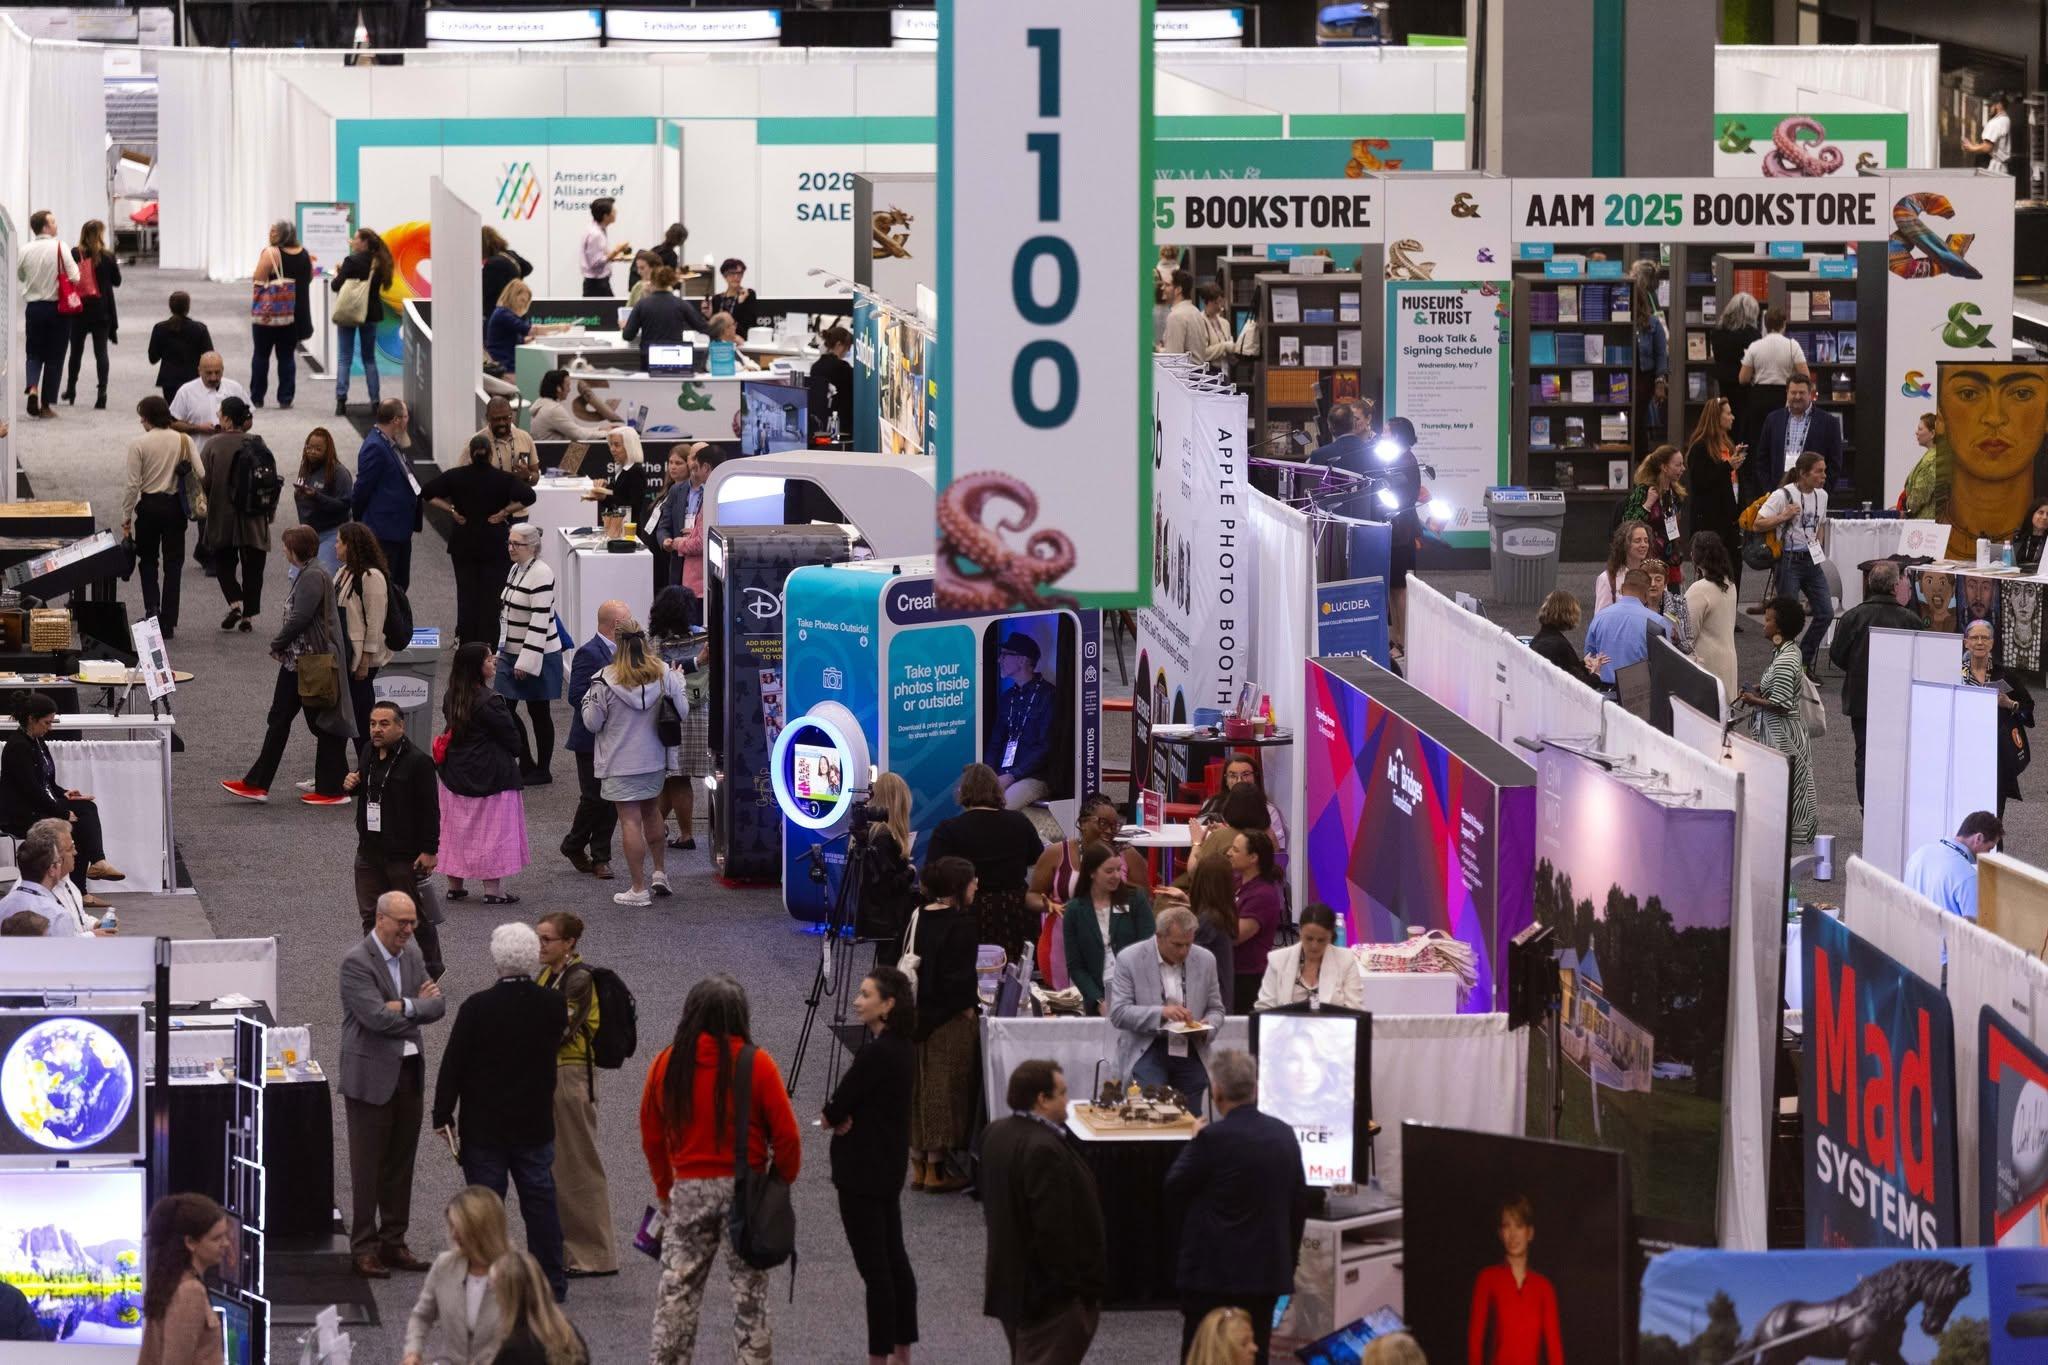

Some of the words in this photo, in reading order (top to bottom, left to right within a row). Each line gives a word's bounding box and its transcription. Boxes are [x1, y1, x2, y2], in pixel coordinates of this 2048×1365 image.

[554, 171, 617, 182] American
[799, 172, 855, 191] 2026
[554, 185, 606, 196] Alliance
[611, 185, 624, 196] of
[797, 203, 851, 221] SALE
[1185, 195, 1371, 229] BOOKSTORE
[1526, 194, 1595, 227] AAM
[1604, 193, 1683, 227] 2025
[1693, 192, 1876, 227] BOOKSTORE
[1402, 296, 1464, 310] MUSEUMS
[1413, 310, 1429, 325] &
[1429, 311, 1472, 325] TRUST
[1418, 334, 1444, 343] Book
[1446, 334, 1467, 343] Talk
[1469, 334, 1478, 343] &
[1403, 346, 1443, 358] Signing
[1444, 346, 1493, 355] Schedule
[1421, 423, 1453, 431] Thursday,
[1218, 427, 1235, 505] APPLE
[1219, 519, 1236, 605] PHOTO
[1331, 599, 1371, 613] LUCIDEA
[797, 618, 814, 628] Take
[814, 620, 839, 631] Photos
[840, 622, 870, 634] Outside!
[1217, 619, 1235, 705] BOOTH
[904, 664, 932, 680] Take
[934, 663, 960, 679] your
[893, 681, 933, 699] photos
[936, 677, 970, 692] inside
[903, 700, 916, 712] or
[918, 692, 964, 709] outside!
[897, 724, 922, 732] Download
[926, 721, 938, 730] print
[938, 720, 949, 729] your
[949, 718, 966, 728] photos
[1087, 727, 1095, 766] PHOTOS
[1387, 755, 1398, 785] Art
[1401, 763, 1423, 806] Bridges
[1392, 788, 1412, 816] Foundation
[1814, 944, 1936, 1206] Mad
[1309, 1164, 1346, 1178] Mad
[1816, 1133, 1938, 1249] SYSTEMS
